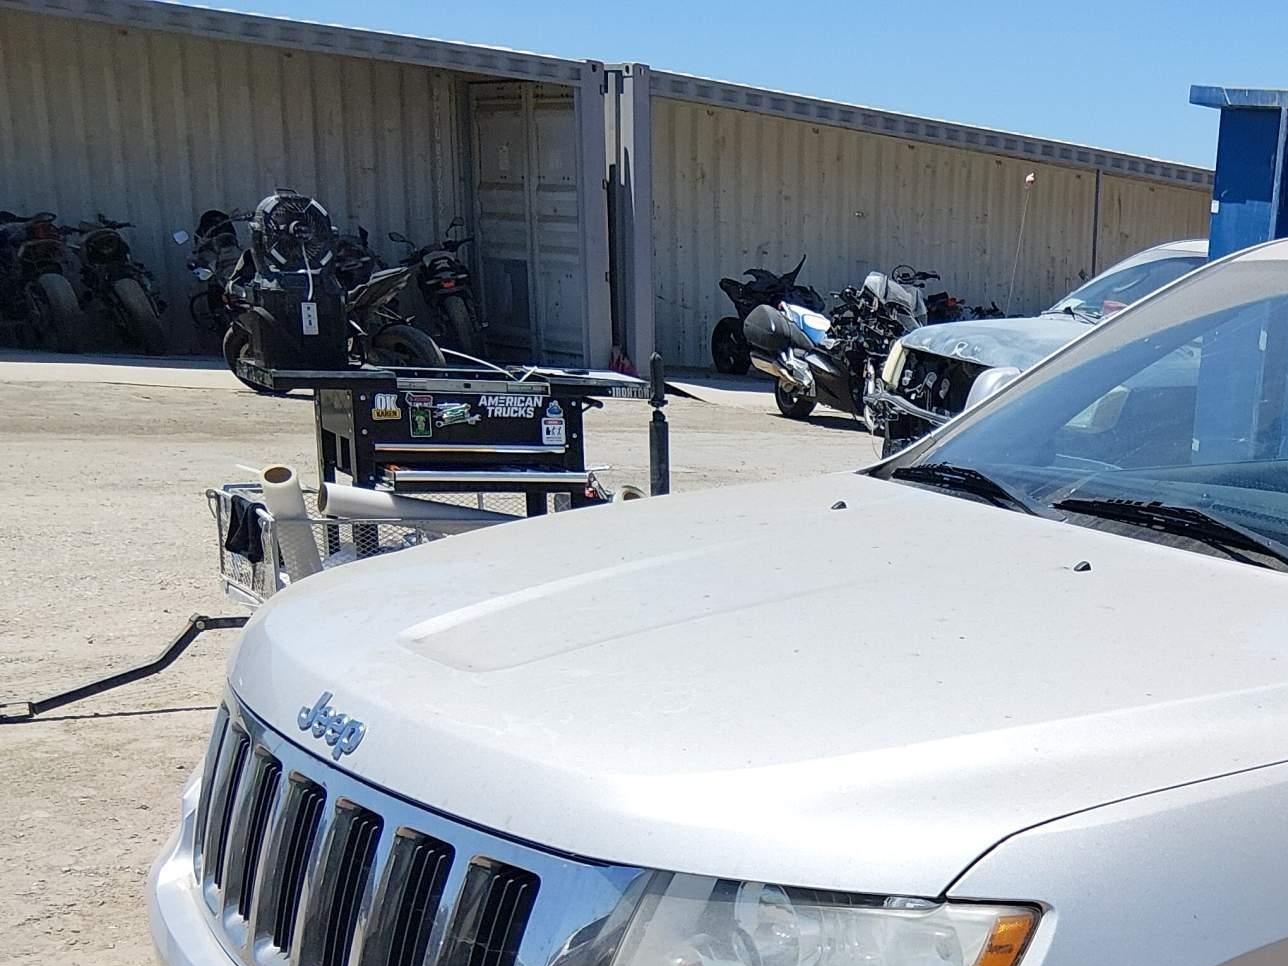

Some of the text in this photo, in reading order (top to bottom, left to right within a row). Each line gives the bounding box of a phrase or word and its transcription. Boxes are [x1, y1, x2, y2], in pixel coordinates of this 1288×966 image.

[375, 394, 398, 410] OK
[478, 395, 543, 408] AMERICAN
[486, 406, 535, 418] TRUCKS
[297, 691, 366, 761] Jeep
